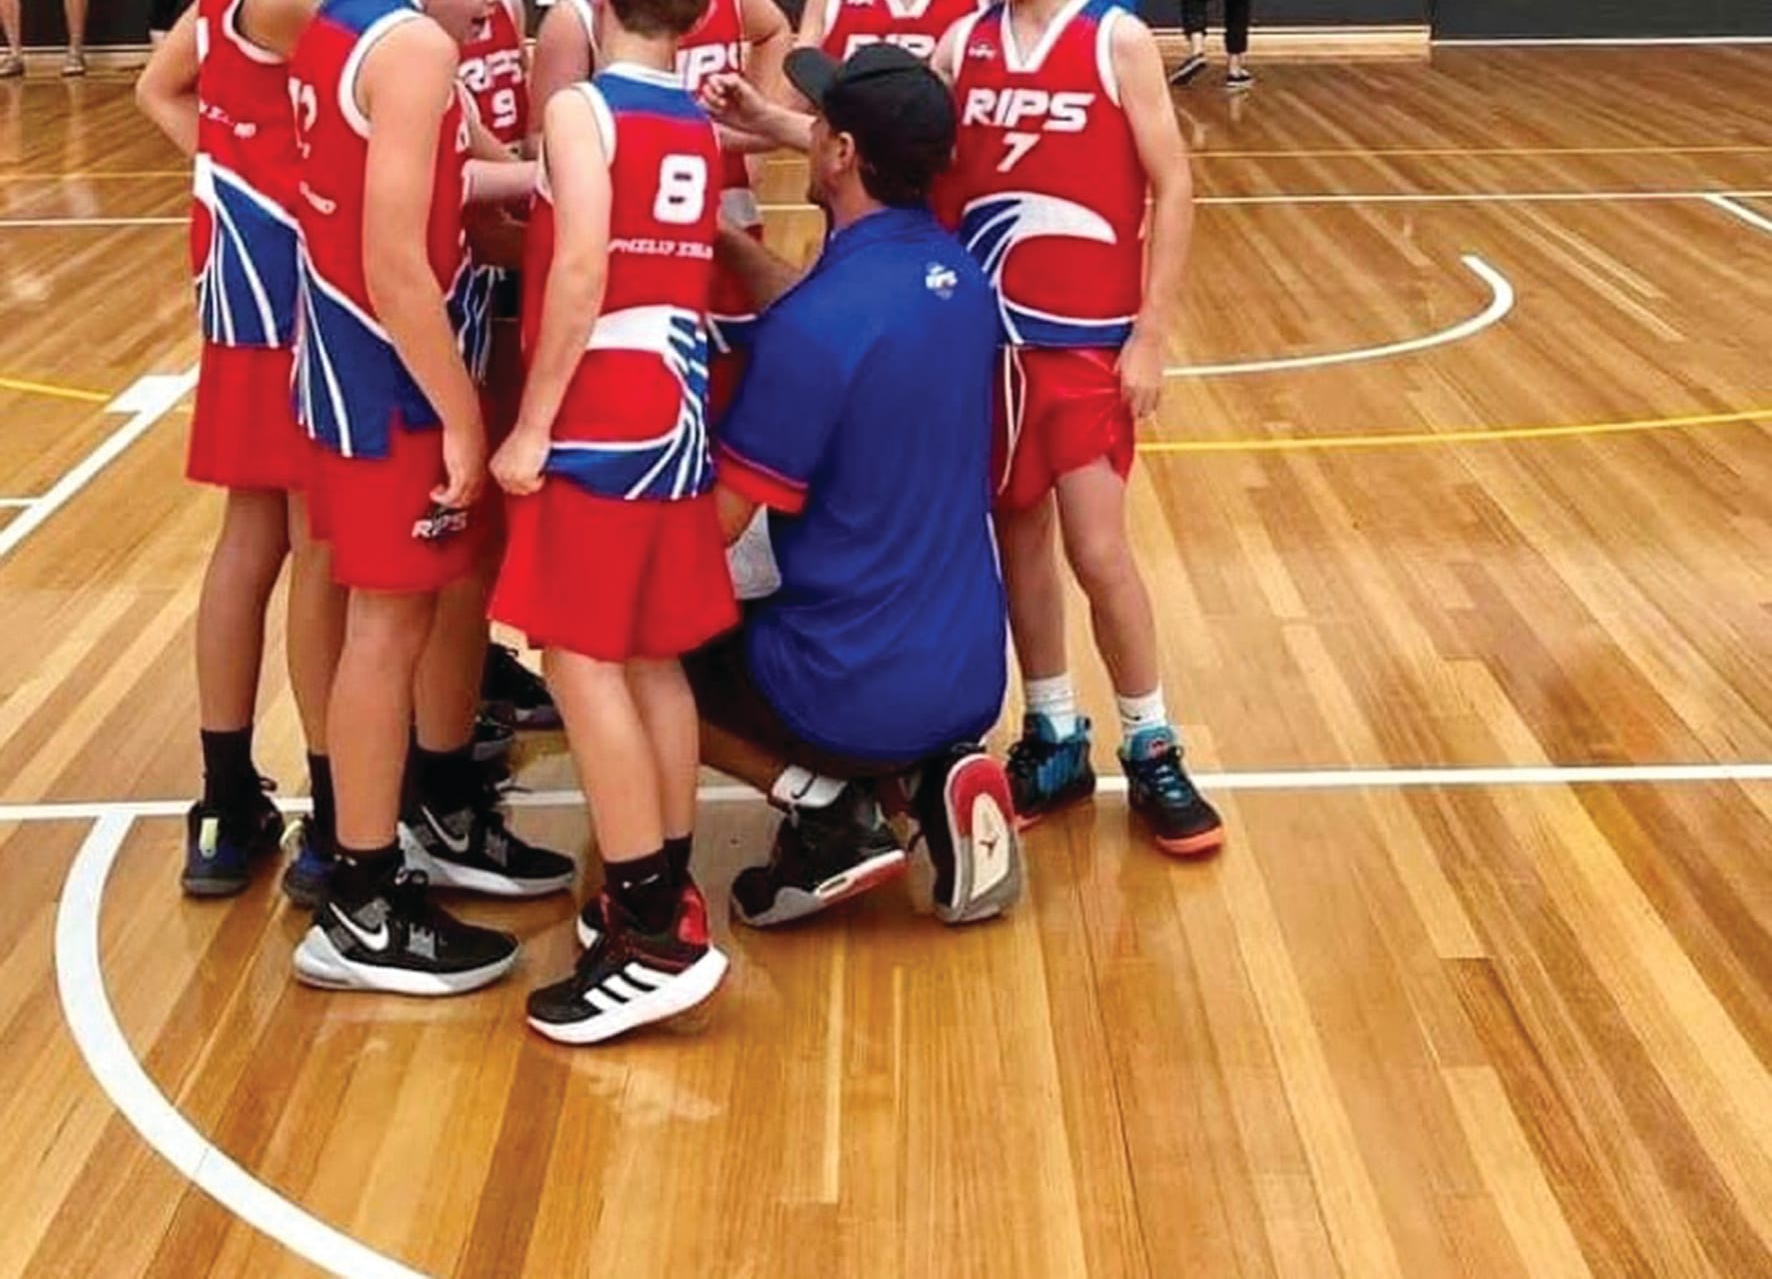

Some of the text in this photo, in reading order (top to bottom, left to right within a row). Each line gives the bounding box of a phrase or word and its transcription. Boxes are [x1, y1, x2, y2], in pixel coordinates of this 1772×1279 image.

[492, 88, 518, 129] 9
[962, 87, 1097, 133] RIPS
[996, 131, 1042, 173] 7
[652, 152, 708, 225] 8
